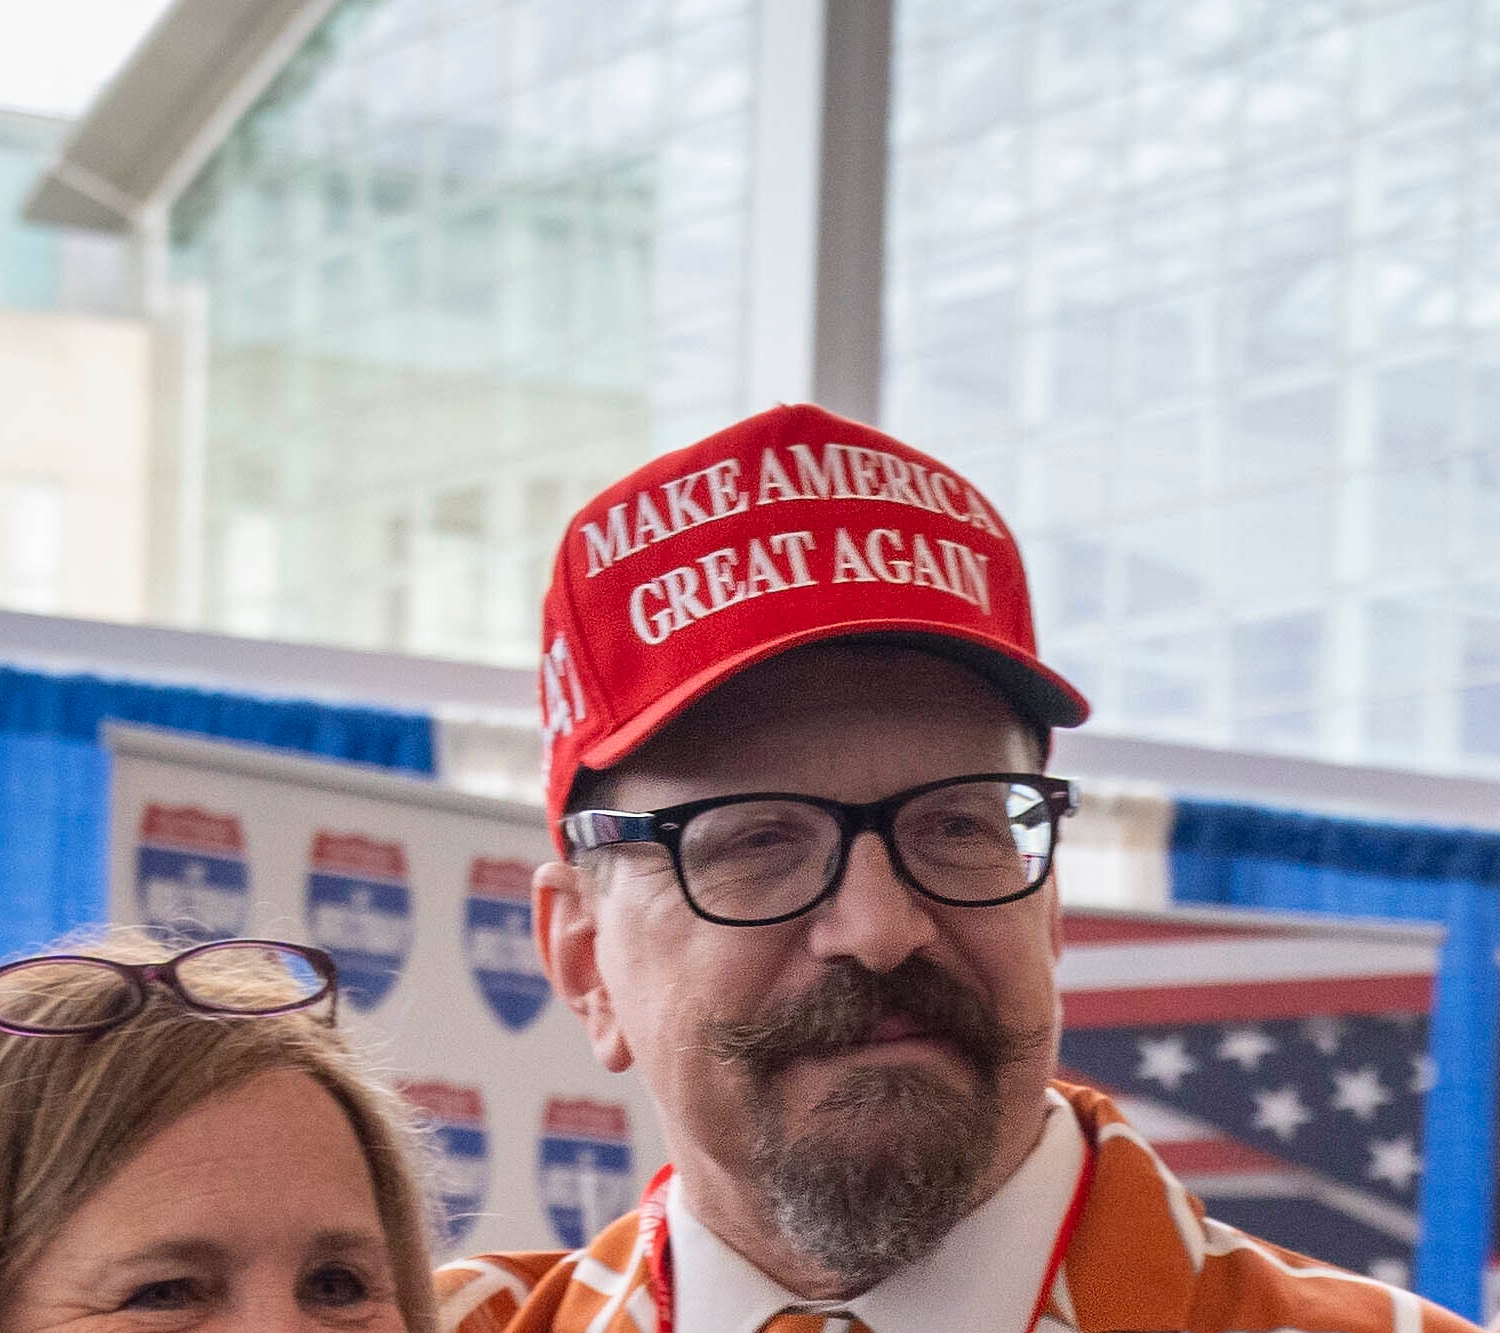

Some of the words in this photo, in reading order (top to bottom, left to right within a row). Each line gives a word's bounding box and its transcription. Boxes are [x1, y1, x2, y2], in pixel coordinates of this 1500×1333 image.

[579, 460, 750, 578] MAKE
[756, 443, 1006, 539] AMERICA
[629, 530, 819, 645] GREAT
[833, 528, 991, 616] AGAIN
